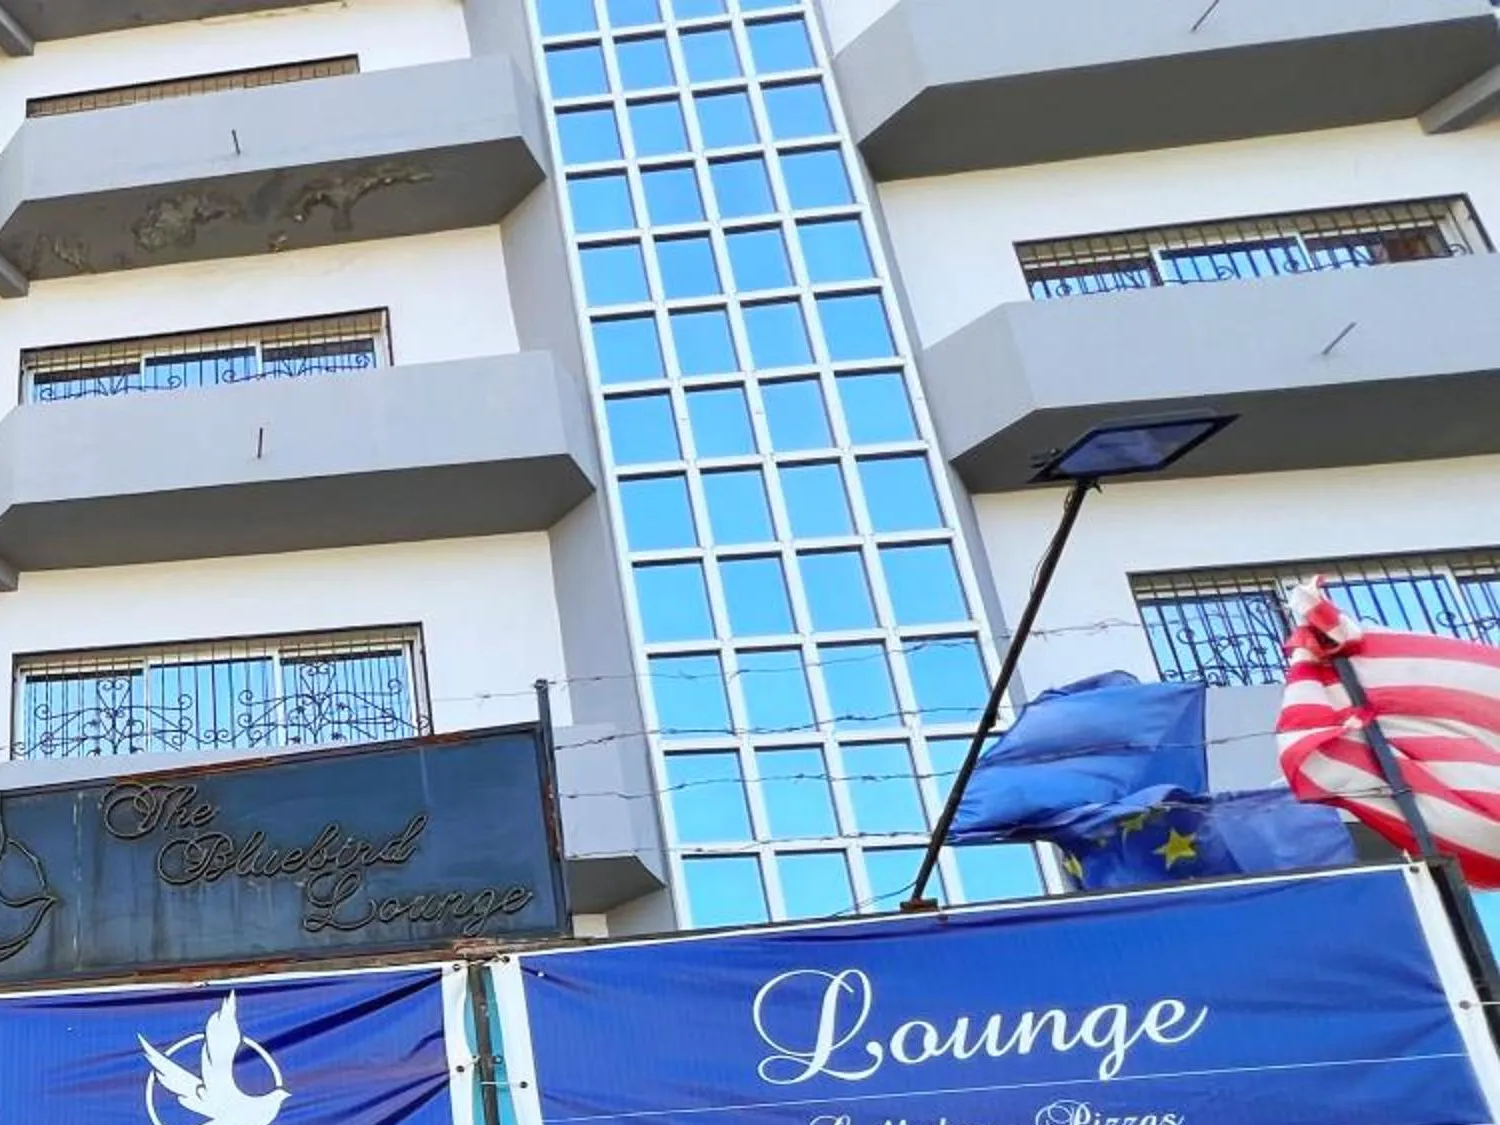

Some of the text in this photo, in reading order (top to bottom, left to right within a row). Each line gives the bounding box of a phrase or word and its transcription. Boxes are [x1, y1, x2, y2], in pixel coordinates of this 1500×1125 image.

[102, 782, 220, 840] The
[156, 814, 431, 885] Bluebird
[304, 870, 535, 937] Lounge
[752, 968, 1209, 1085] Lounge
